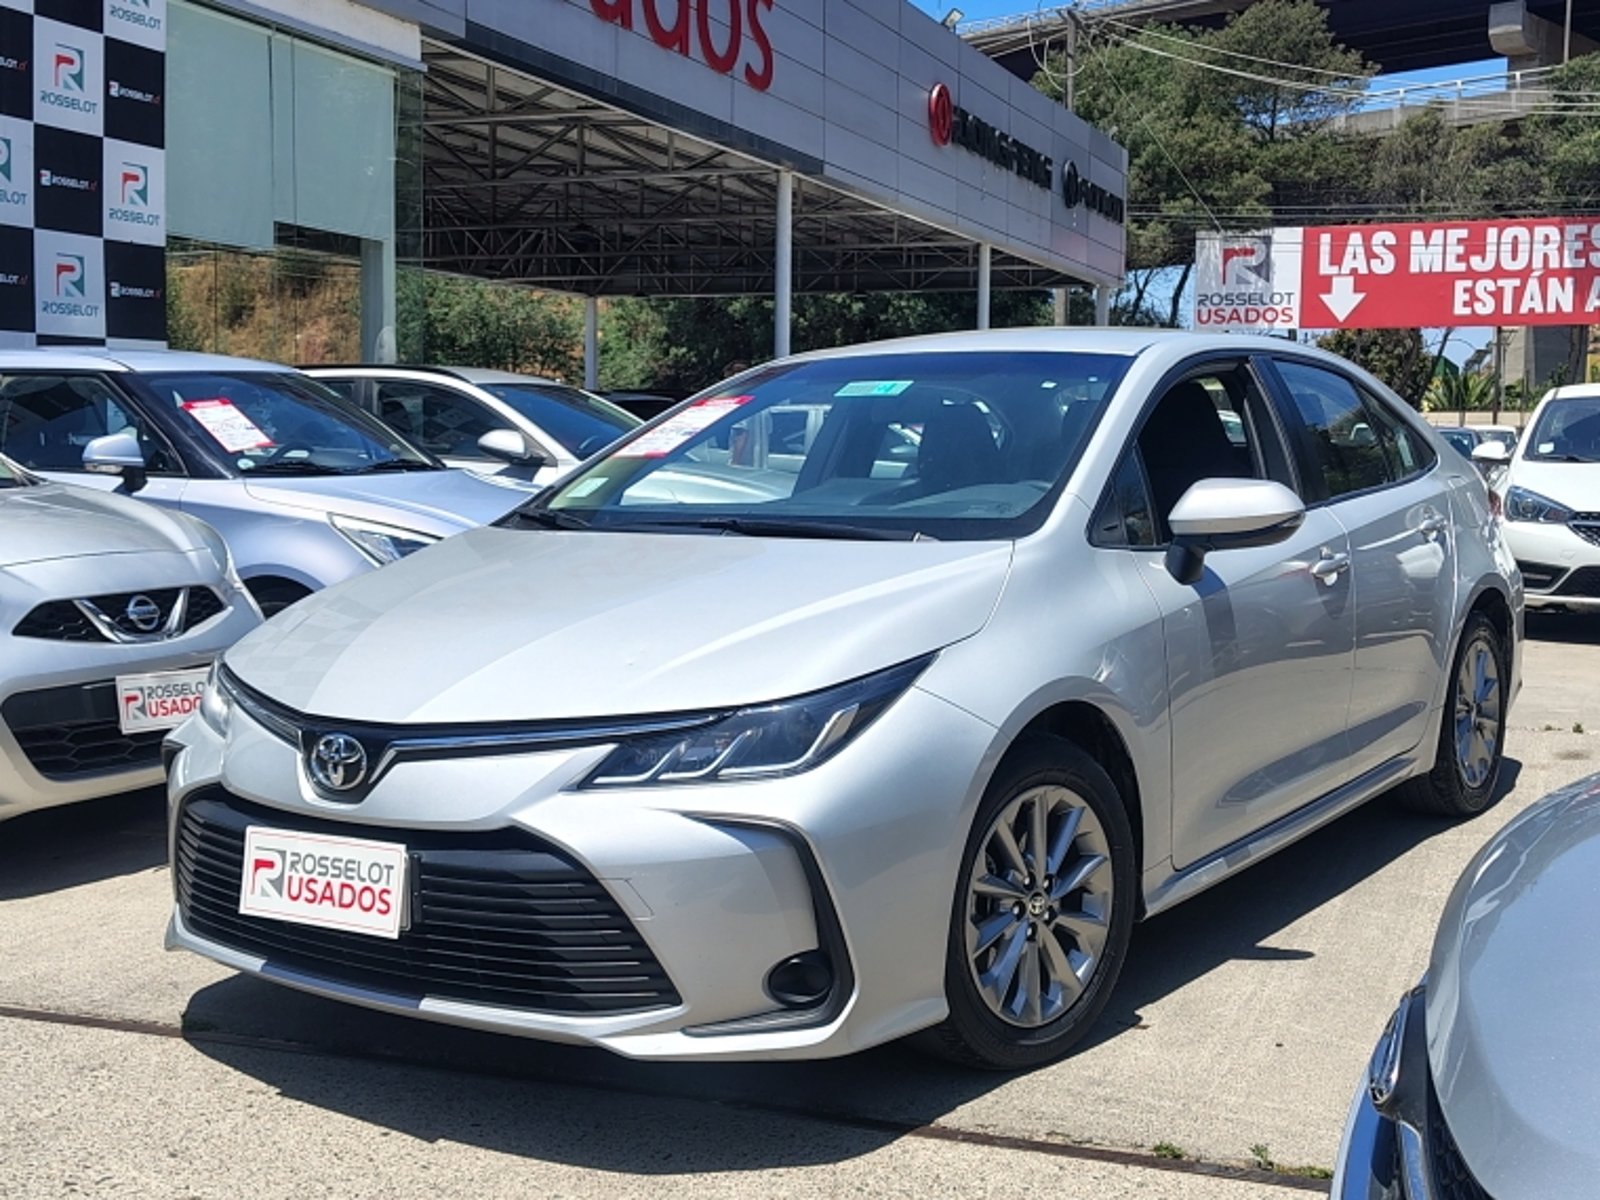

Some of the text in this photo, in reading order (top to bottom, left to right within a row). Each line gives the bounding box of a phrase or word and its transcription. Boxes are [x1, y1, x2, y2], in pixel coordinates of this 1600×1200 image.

[40, 90, 98, 114] ROSSELOT
[109, 207, 161, 226] ROSSELOT
[1319, 231, 1397, 276] LAS
[1197, 292, 1294, 308] ROSSELOT
[1453, 268, 1574, 316] ESTÁN
[42, 301, 99, 318] ROSSELOT
[1197, 306, 1294, 325] USADOS
[147, 682, 206, 699] ROSSELO
[148, 696, 203, 718] USAD
[289, 852, 394, 886] ROSSELOT
[287, 875, 392, 915] USADOS
